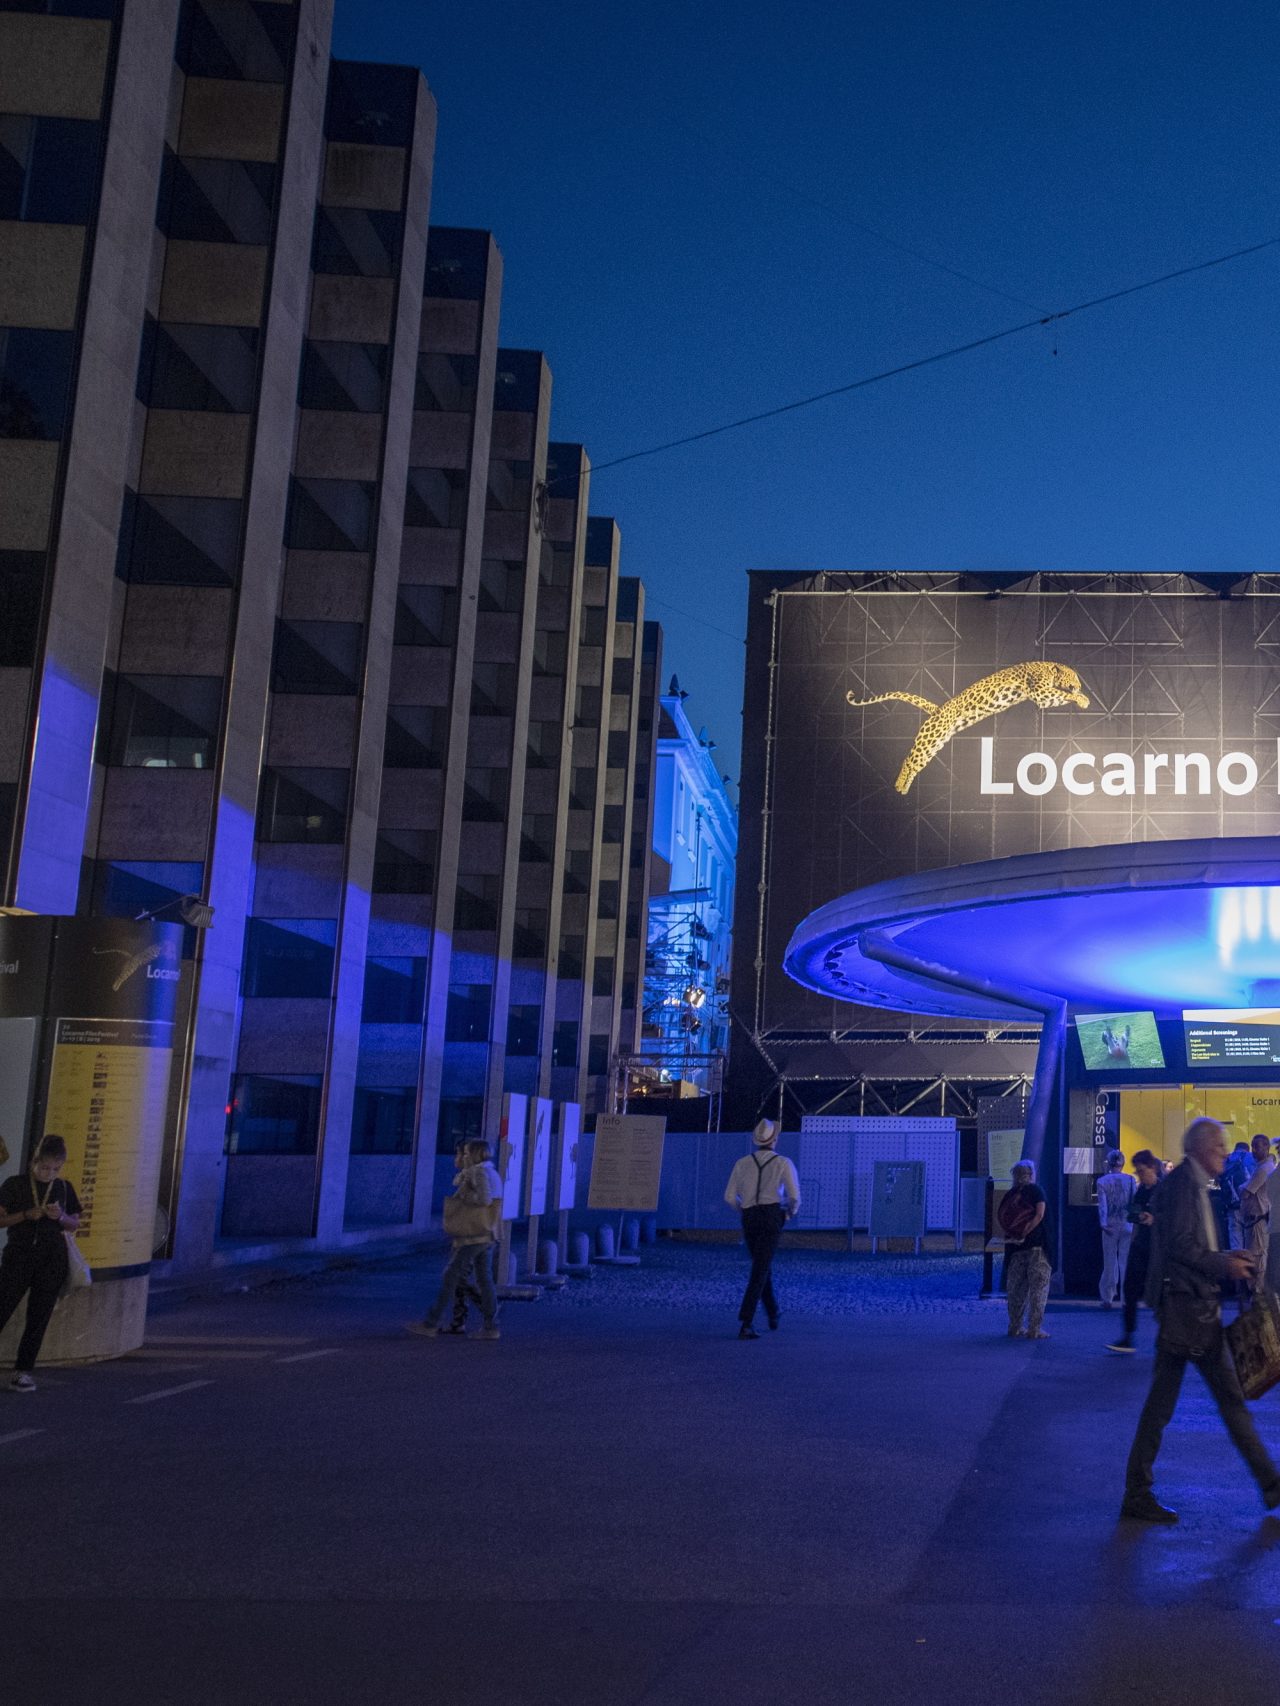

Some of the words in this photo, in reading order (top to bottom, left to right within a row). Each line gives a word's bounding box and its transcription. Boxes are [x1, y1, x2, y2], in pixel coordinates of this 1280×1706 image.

[980, 737, 1257, 797] Locarno
[602, 1117, 621, 1125] Info
[1095, 1091, 1110, 1146] Cassa
